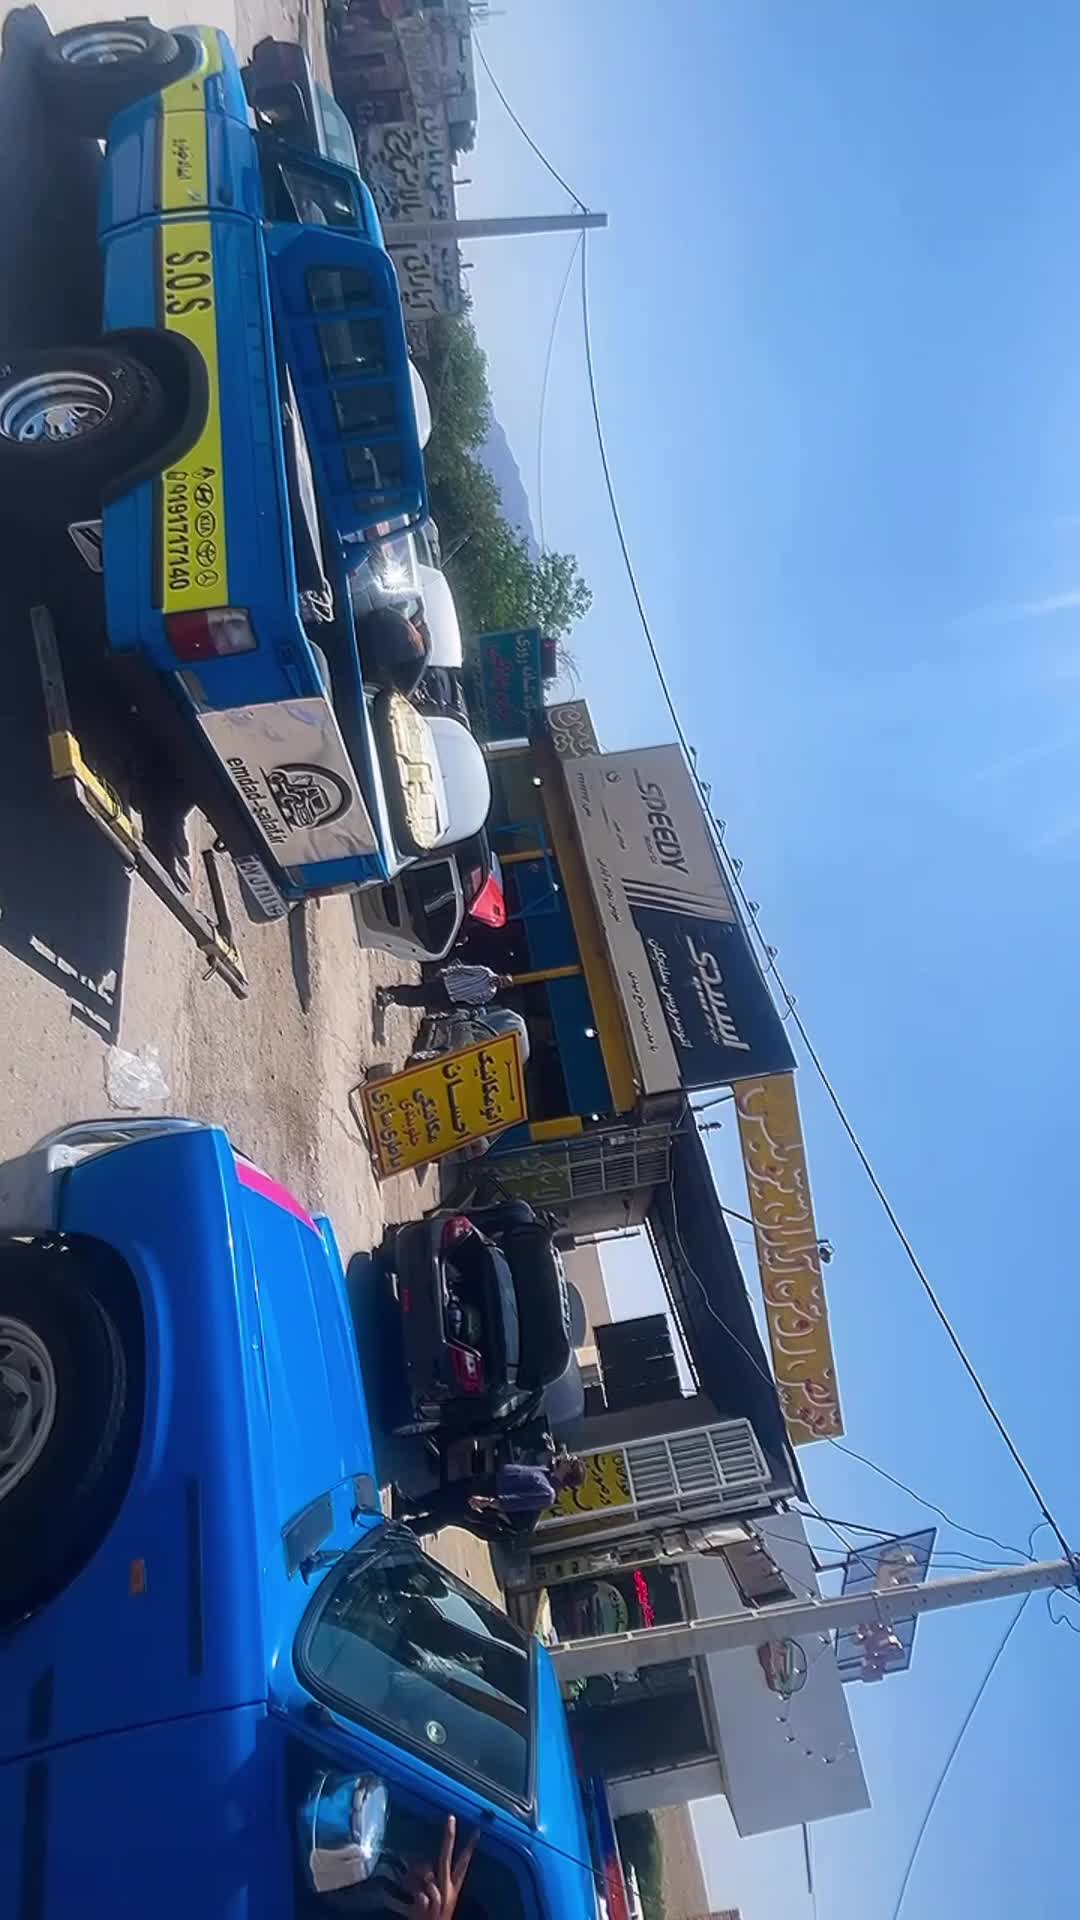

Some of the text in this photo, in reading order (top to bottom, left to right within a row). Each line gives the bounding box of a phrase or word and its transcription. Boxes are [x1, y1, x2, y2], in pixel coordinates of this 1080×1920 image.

[164, 250, 213, 317] S.O.S
[226, 757, 287, 845] emdad-salaf.ir
[634, 768, 690, 874] SPEEDY
[661, 986, 694, 1048] اتوسرویس
[686, 935, 751, 1051] اسپیدی
[400, 1098, 421, 1148] جلوبندی
[413, 1088, 441, 1144] مکانیکی
[442, 1062, 470, 1140] احسان
[474, 1049, 505, 1127] اتومکانیک
